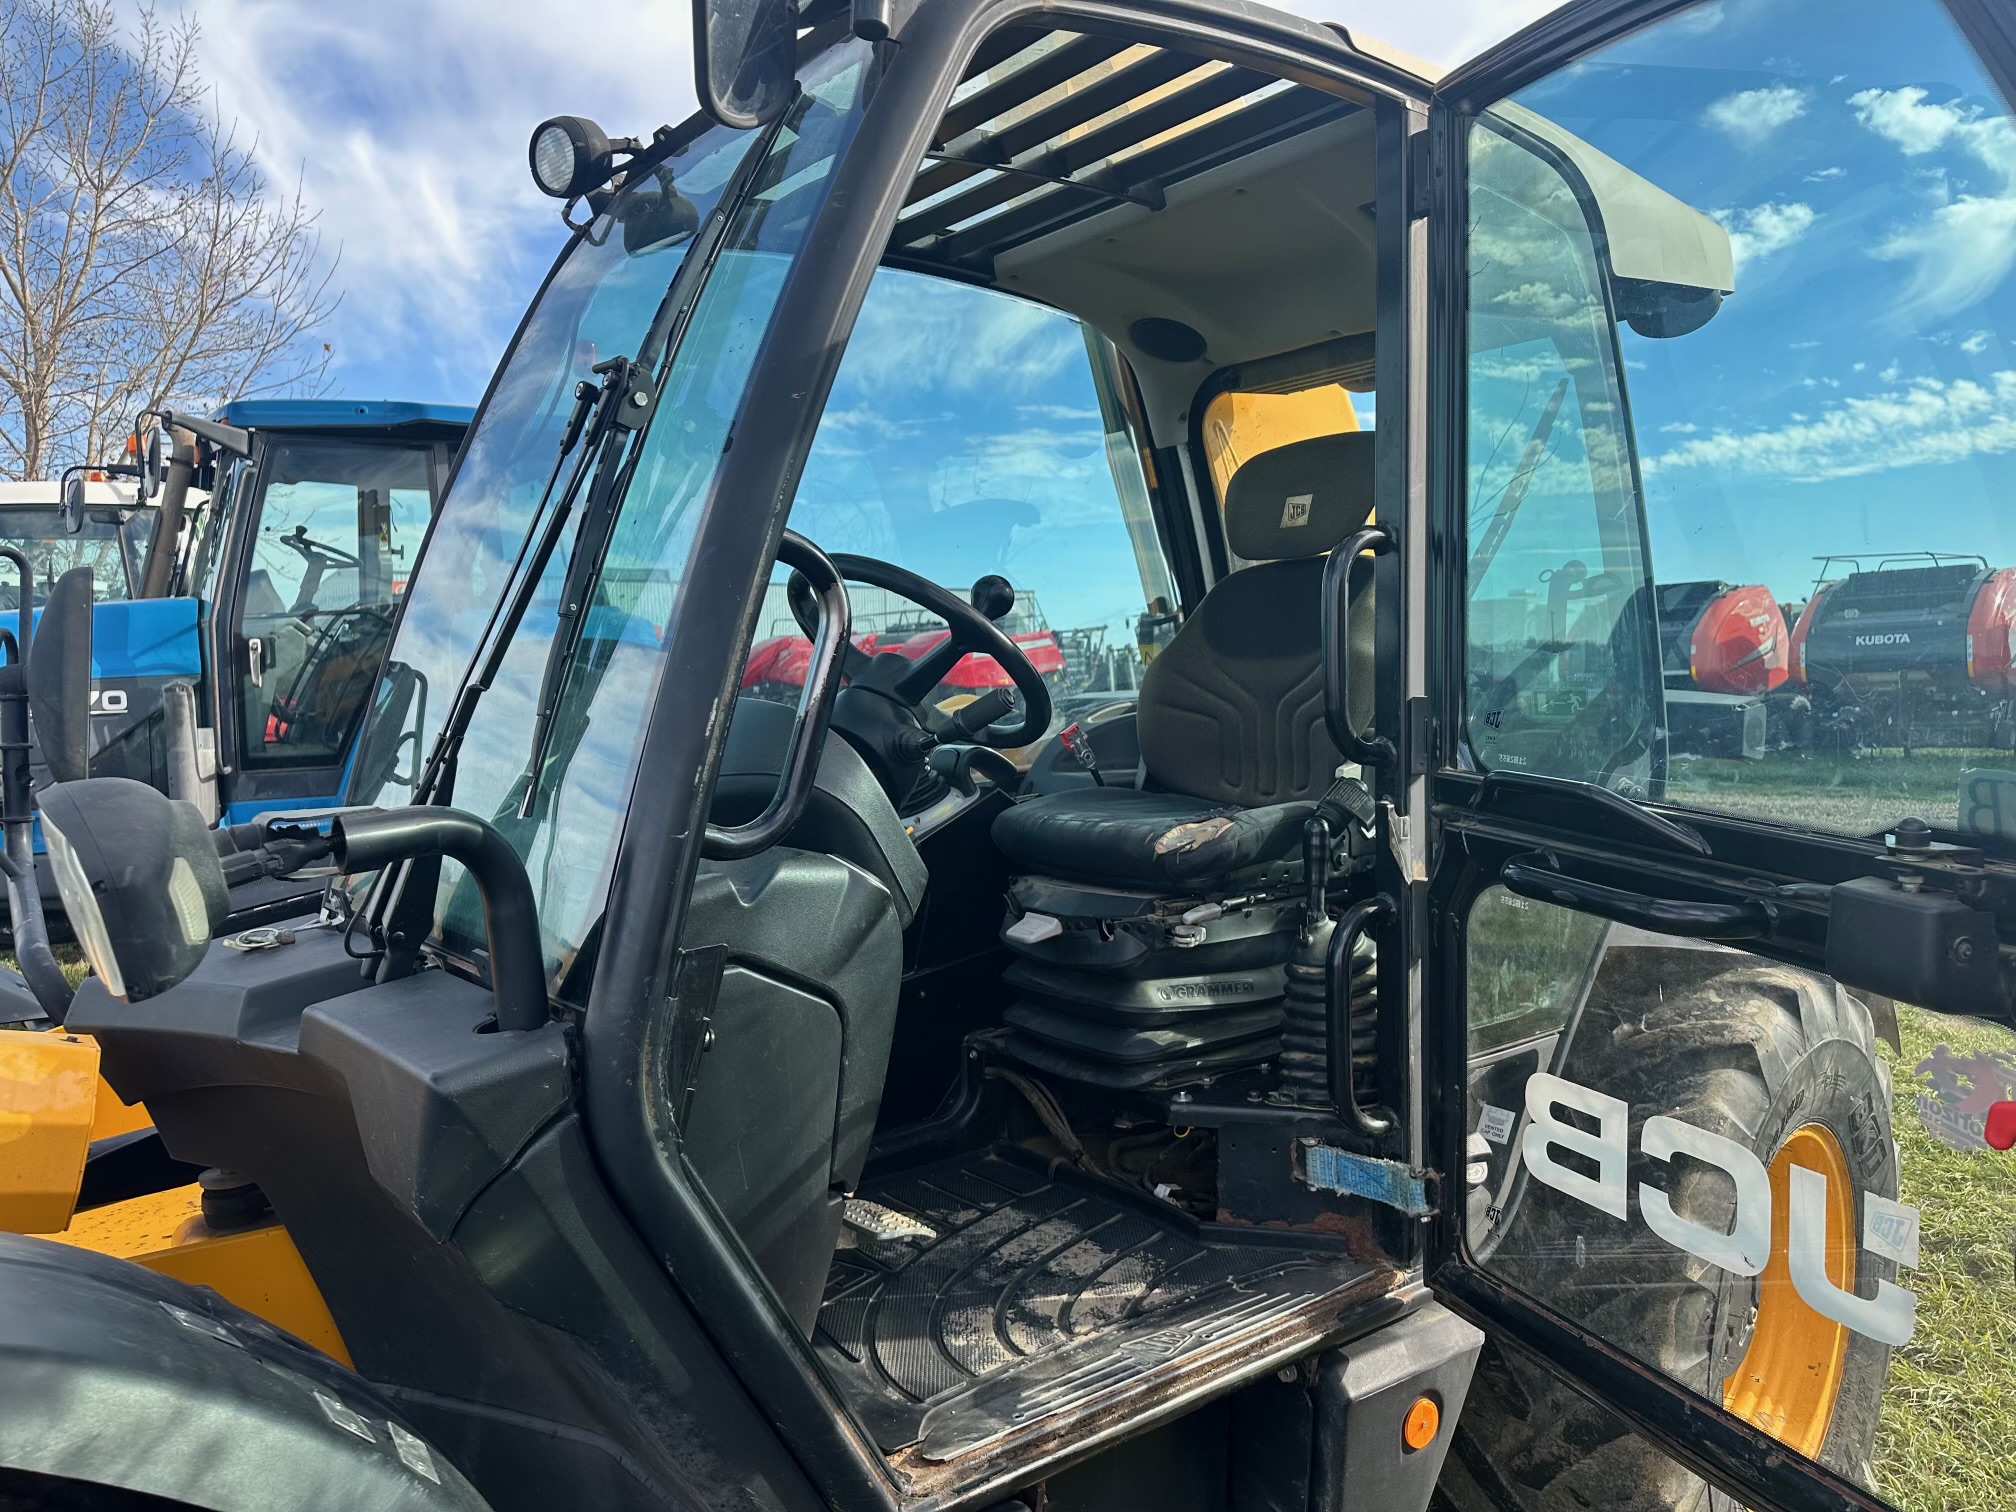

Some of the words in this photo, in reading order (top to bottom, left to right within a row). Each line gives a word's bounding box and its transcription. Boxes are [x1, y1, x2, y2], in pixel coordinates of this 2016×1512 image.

[1290, 504, 1305, 519] JCB
[1855, 632, 1911, 646] KUBOTA
[1176, 982, 1251, 998] GRAMMER
[1484, 1123, 1504, 1133] VENTED
